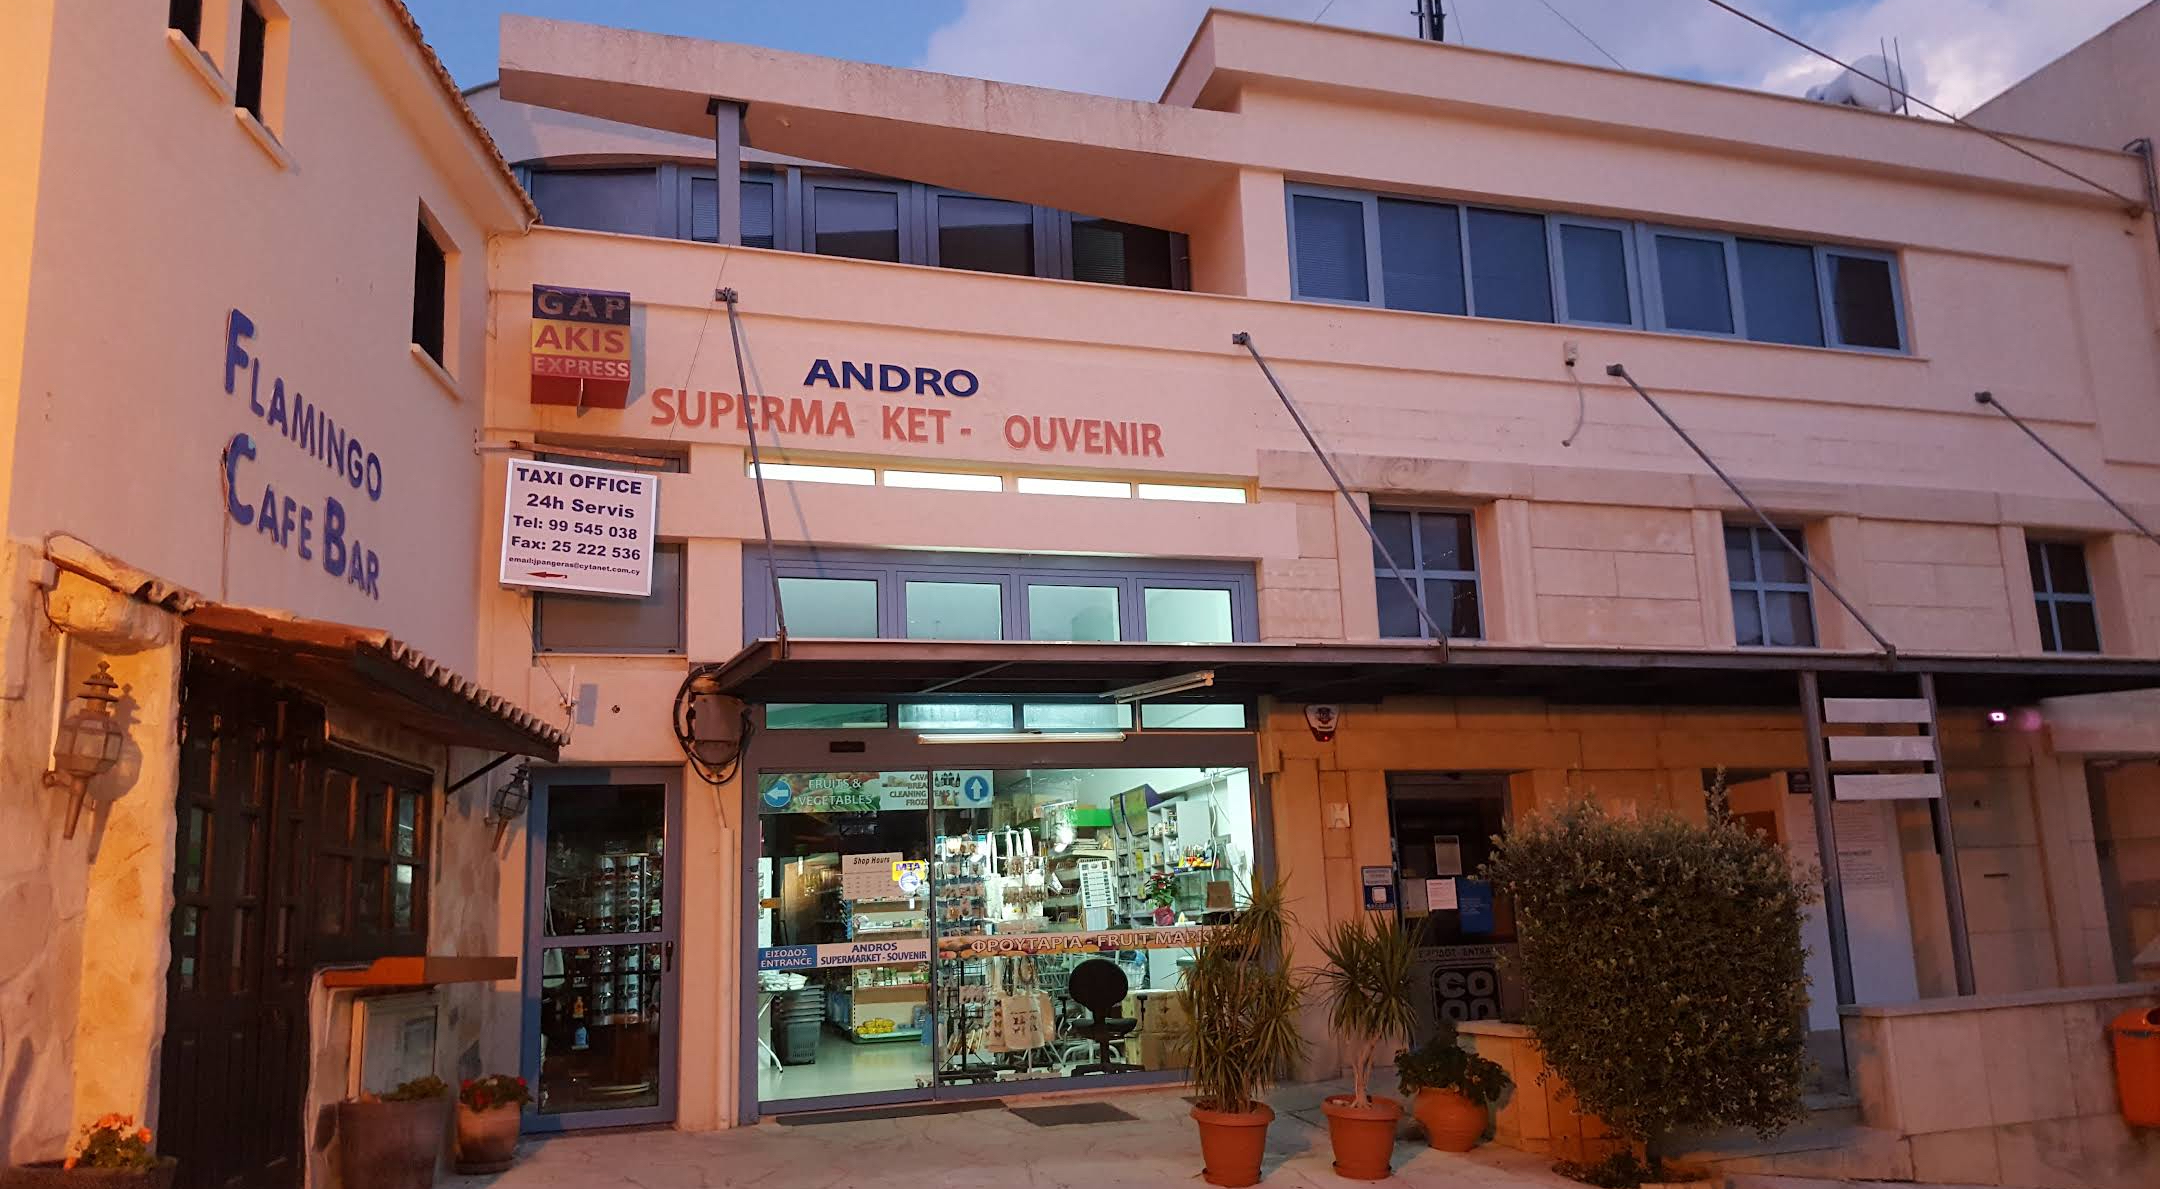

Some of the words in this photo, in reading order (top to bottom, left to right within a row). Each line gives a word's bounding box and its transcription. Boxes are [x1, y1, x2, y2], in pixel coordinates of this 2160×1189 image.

[536, 289, 626, 321] GAP
[534, 324, 625, 354] AKIS
[533, 356, 629, 378] EXPRESS
[803, 358, 980, 398] ANDRO
[224, 308, 382, 501] FLAMINGO
[1003, 413, 1166, 458] OUVENIR
[516, 467, 563, 486] TAXI
[569, 473, 642, 495] OFFICE
[226, 432, 313, 560] CAFE
[323, 496, 379, 600] BAR
[526, 493, 564, 511] 24h
[571, 498, 635, 519] Servis
[512, 515, 543, 530] Tel:
[548, 519, 569, 533] 99
[573, 521, 603, 537] 545
[608, 525, 638, 541] 038
[511, 535, 546, 550] Fax:
[552, 539, 572, 554] 25
[576, 542, 607, 557] 222
[611, 545, 641, 561] 536
[808, 779, 850, 790] FRUITS
[852, 779, 862, 789] &
[889, 790, 927, 799] CLEANING
[799, 794, 873, 807] VEGETABLES
[853, 857, 870, 866] Shop
[871, 857, 890, 865] Hours
[765, 949, 808, 958] ΕΙΣΟΔΟΣ
[851, 942, 898, 953] ANDROS
[970, 935, 1082, 953] ΦΡΟΥΤΑΡΙΑ
[1097, 932, 1151, 949] FRUIT
[761, 958, 813, 968] ENTRANCE
[820, 954, 881, 966] SUPERMARKET
[887, 951, 928, 962] SOUVENIR
